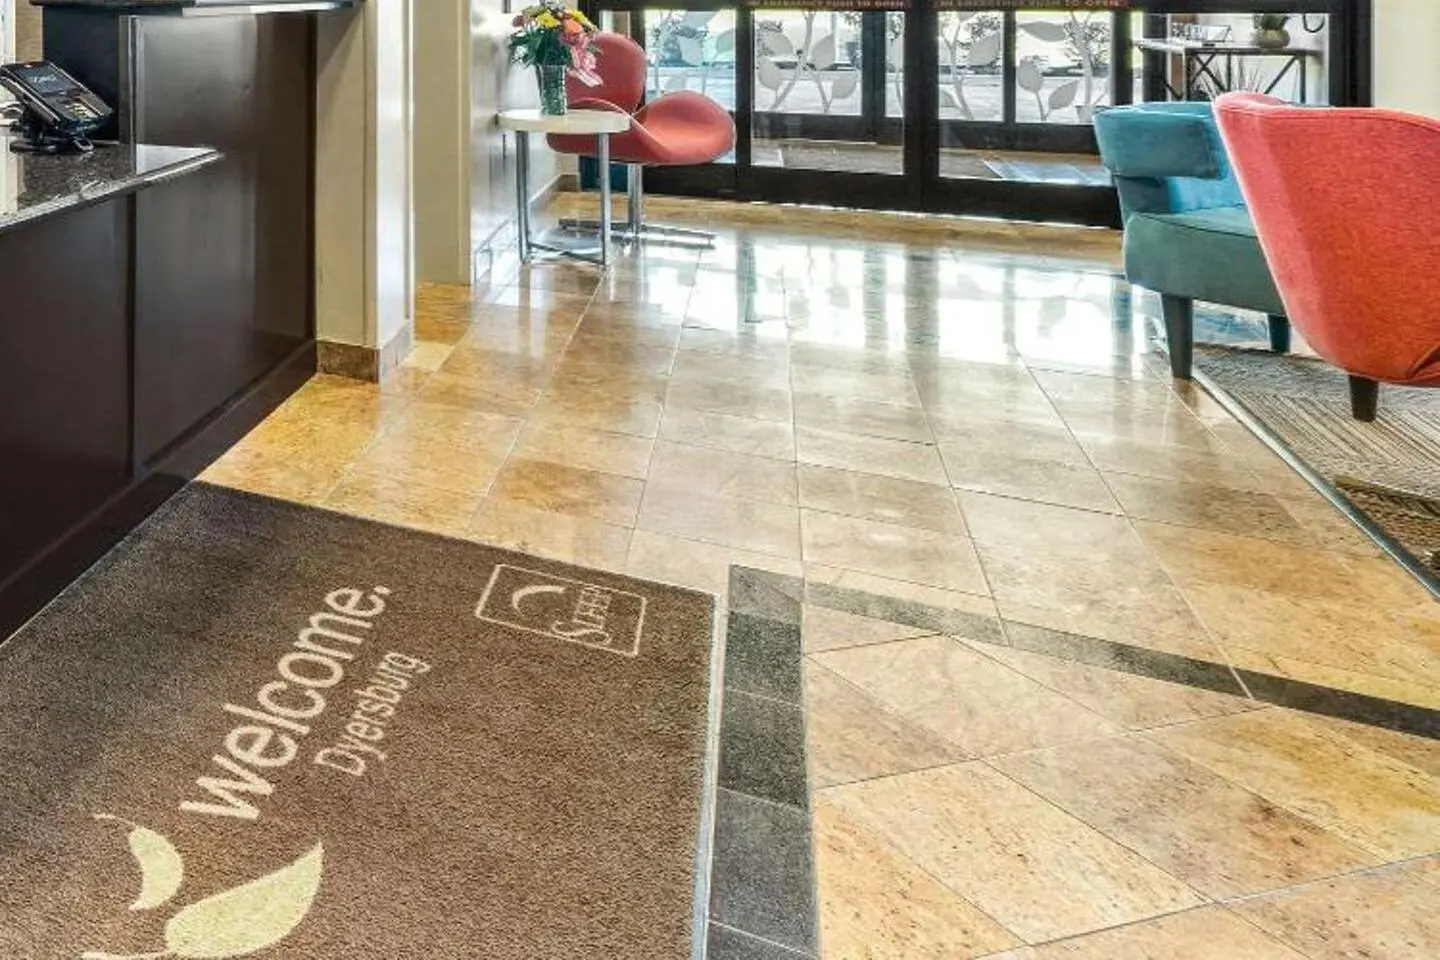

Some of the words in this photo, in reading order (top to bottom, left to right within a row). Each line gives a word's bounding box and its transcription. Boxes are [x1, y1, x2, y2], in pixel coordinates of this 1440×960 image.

[875, 0, 905, 7] OPEN
[1084, 0, 1120, 7] OPEN
[179, 585, 392, 820] welcome.
[314, 651, 431, 777] Dyersburg
